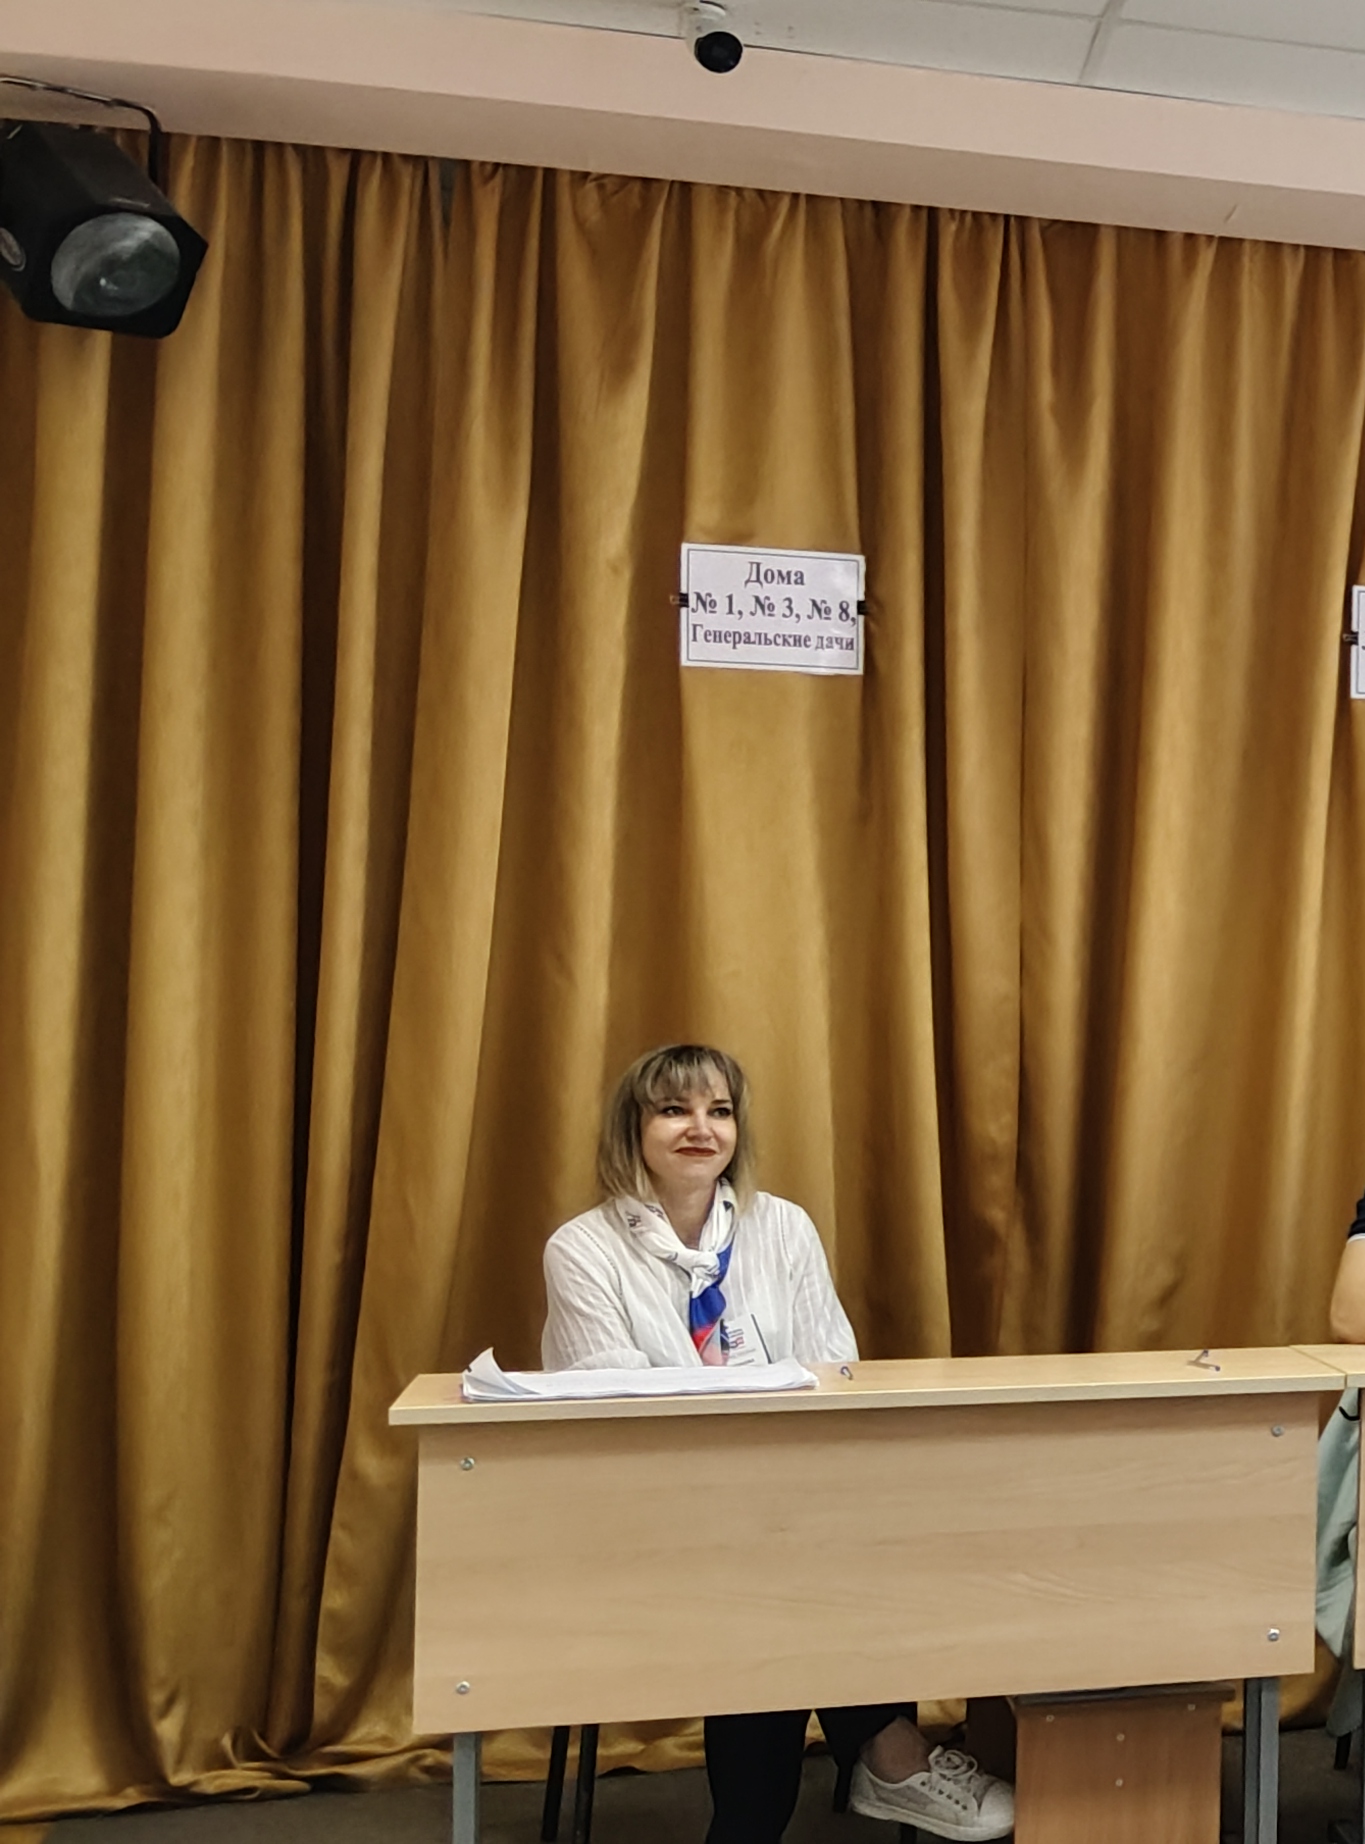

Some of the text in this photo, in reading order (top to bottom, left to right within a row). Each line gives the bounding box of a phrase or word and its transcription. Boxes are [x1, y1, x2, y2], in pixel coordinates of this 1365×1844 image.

[744, 561, 806, 589] Дома
[691, 591, 857, 626] № 1, № 3, № 8,
[691, 623, 855, 651] Генеральские дачи
